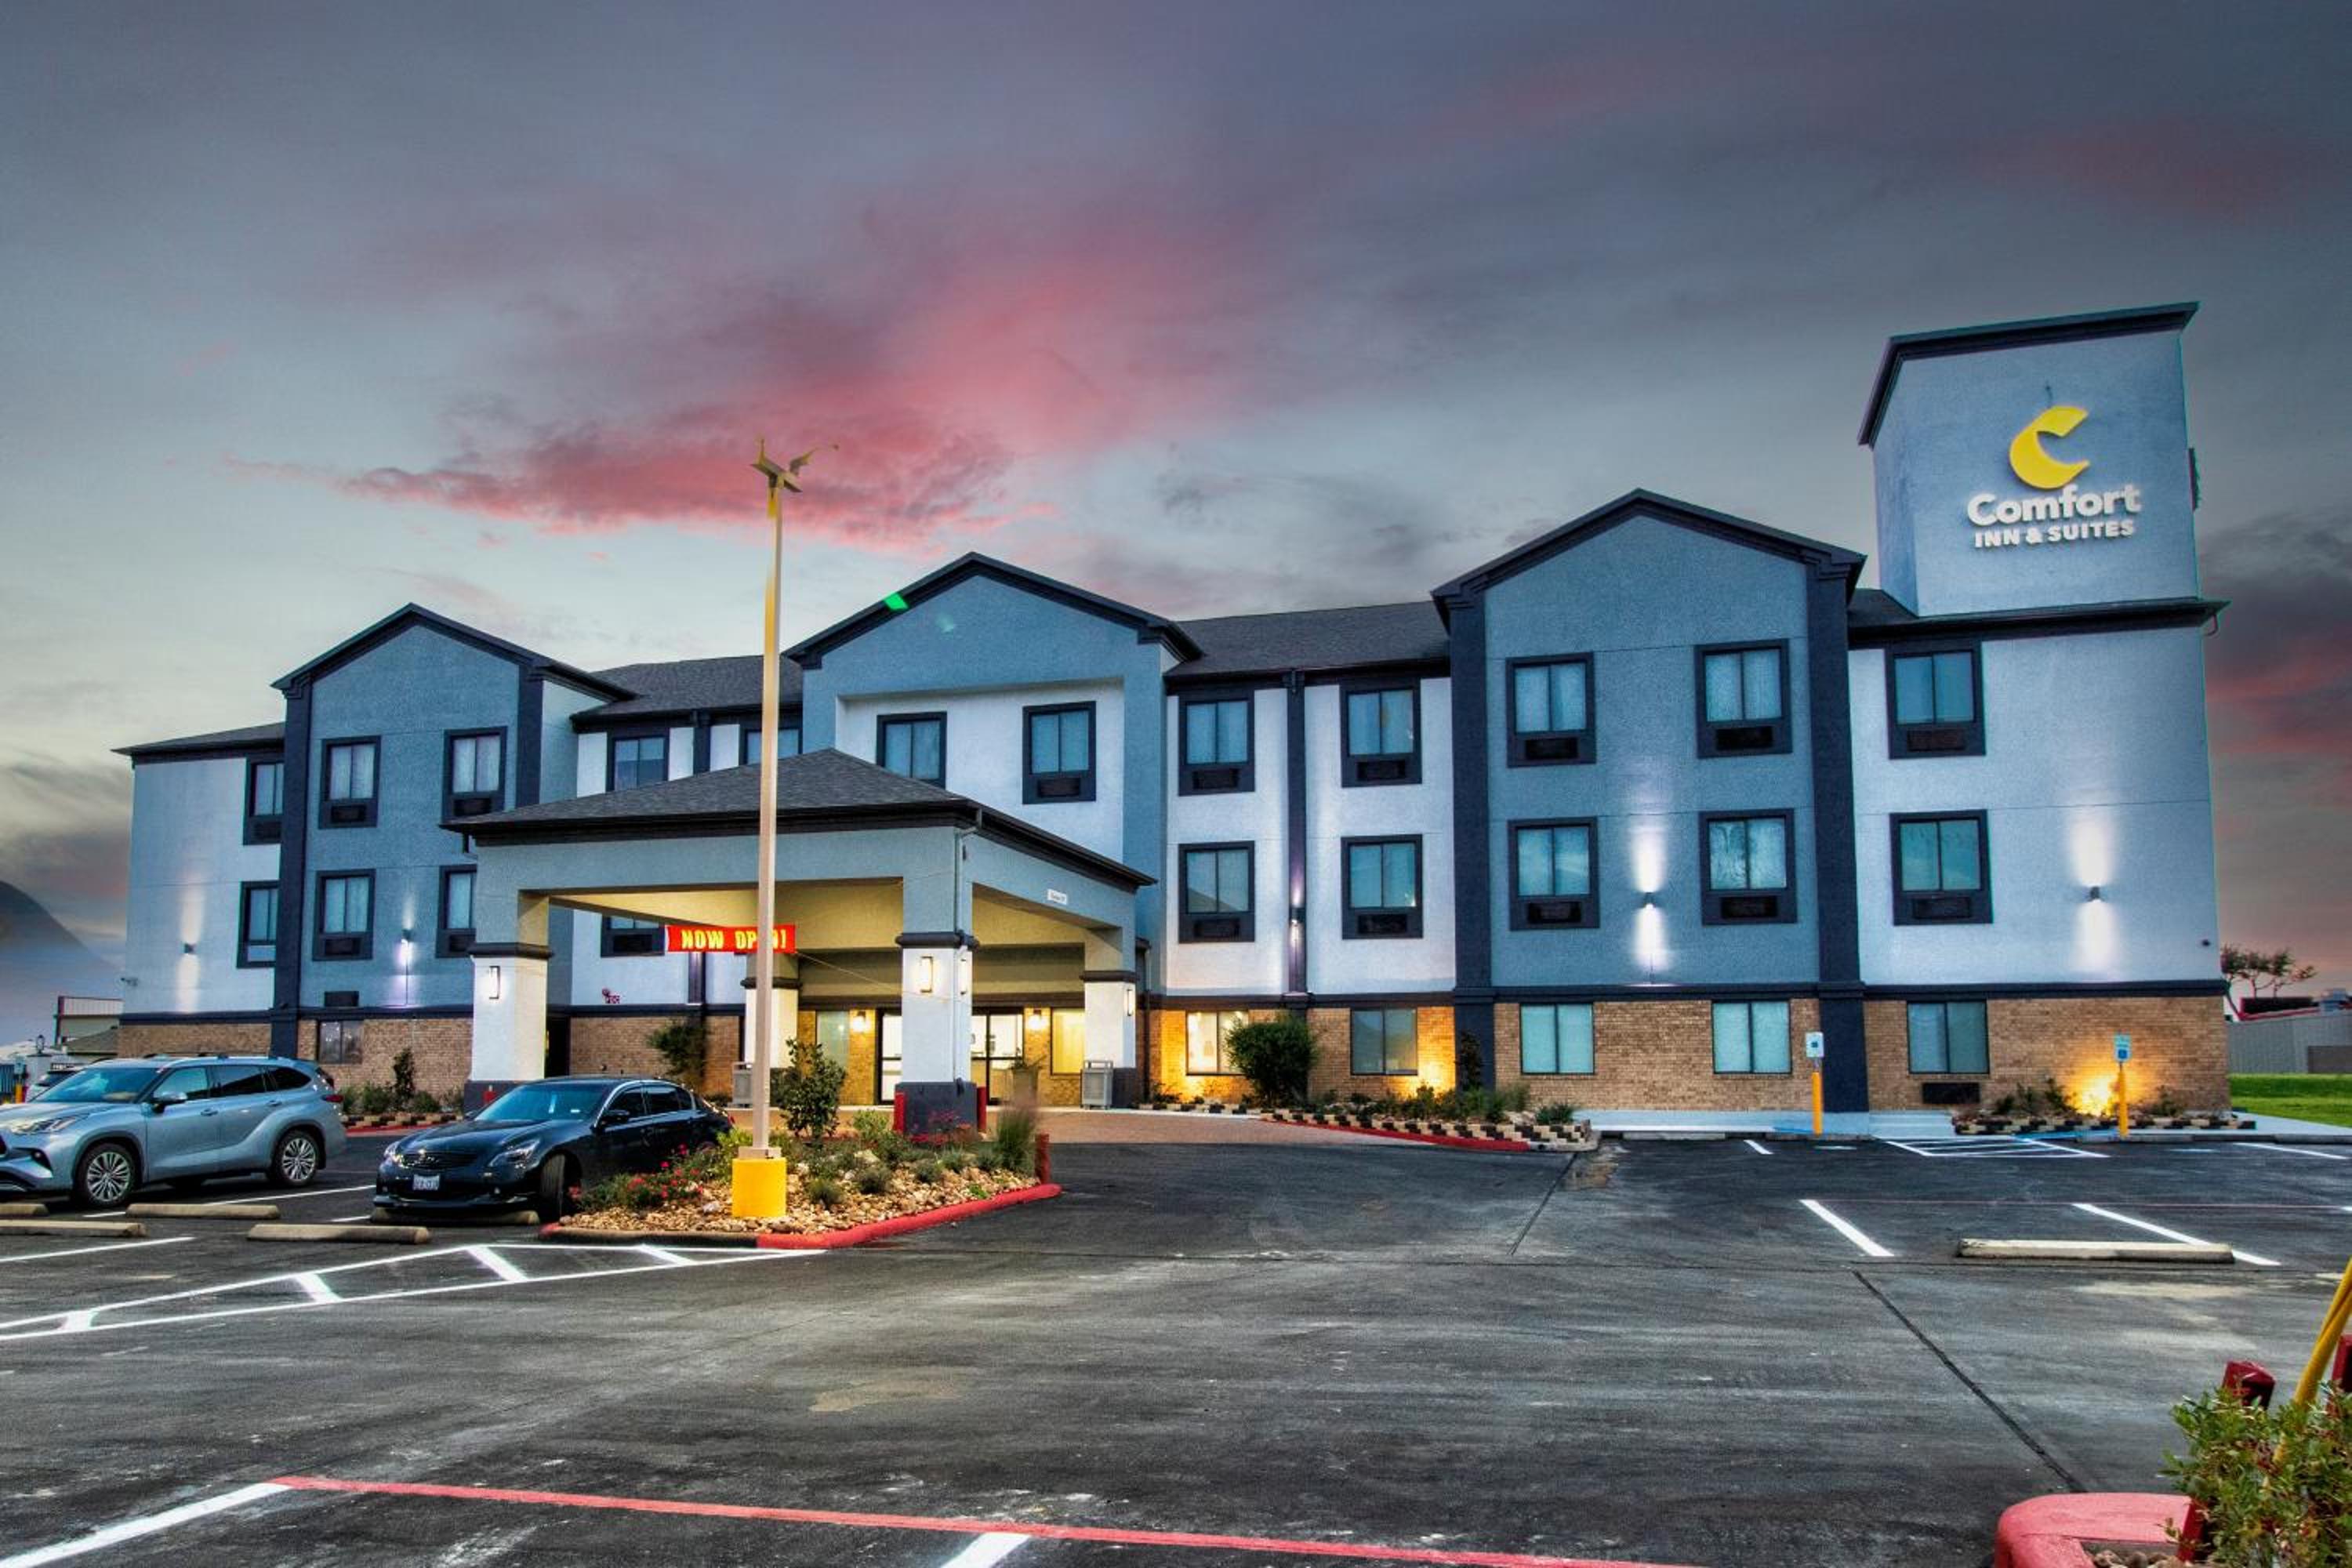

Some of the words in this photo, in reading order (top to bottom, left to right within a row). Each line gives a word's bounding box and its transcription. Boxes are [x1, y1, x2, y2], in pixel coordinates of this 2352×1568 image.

[1967, 484, 2143, 526] Comfort
[1974, 528, 2020, 548] INN
[2026, 527, 2043, 545] &
[2047, 519, 2134, 543] SUITES
[681, 929, 724, 949] NOW
[735, 929, 786, 949] OP!
